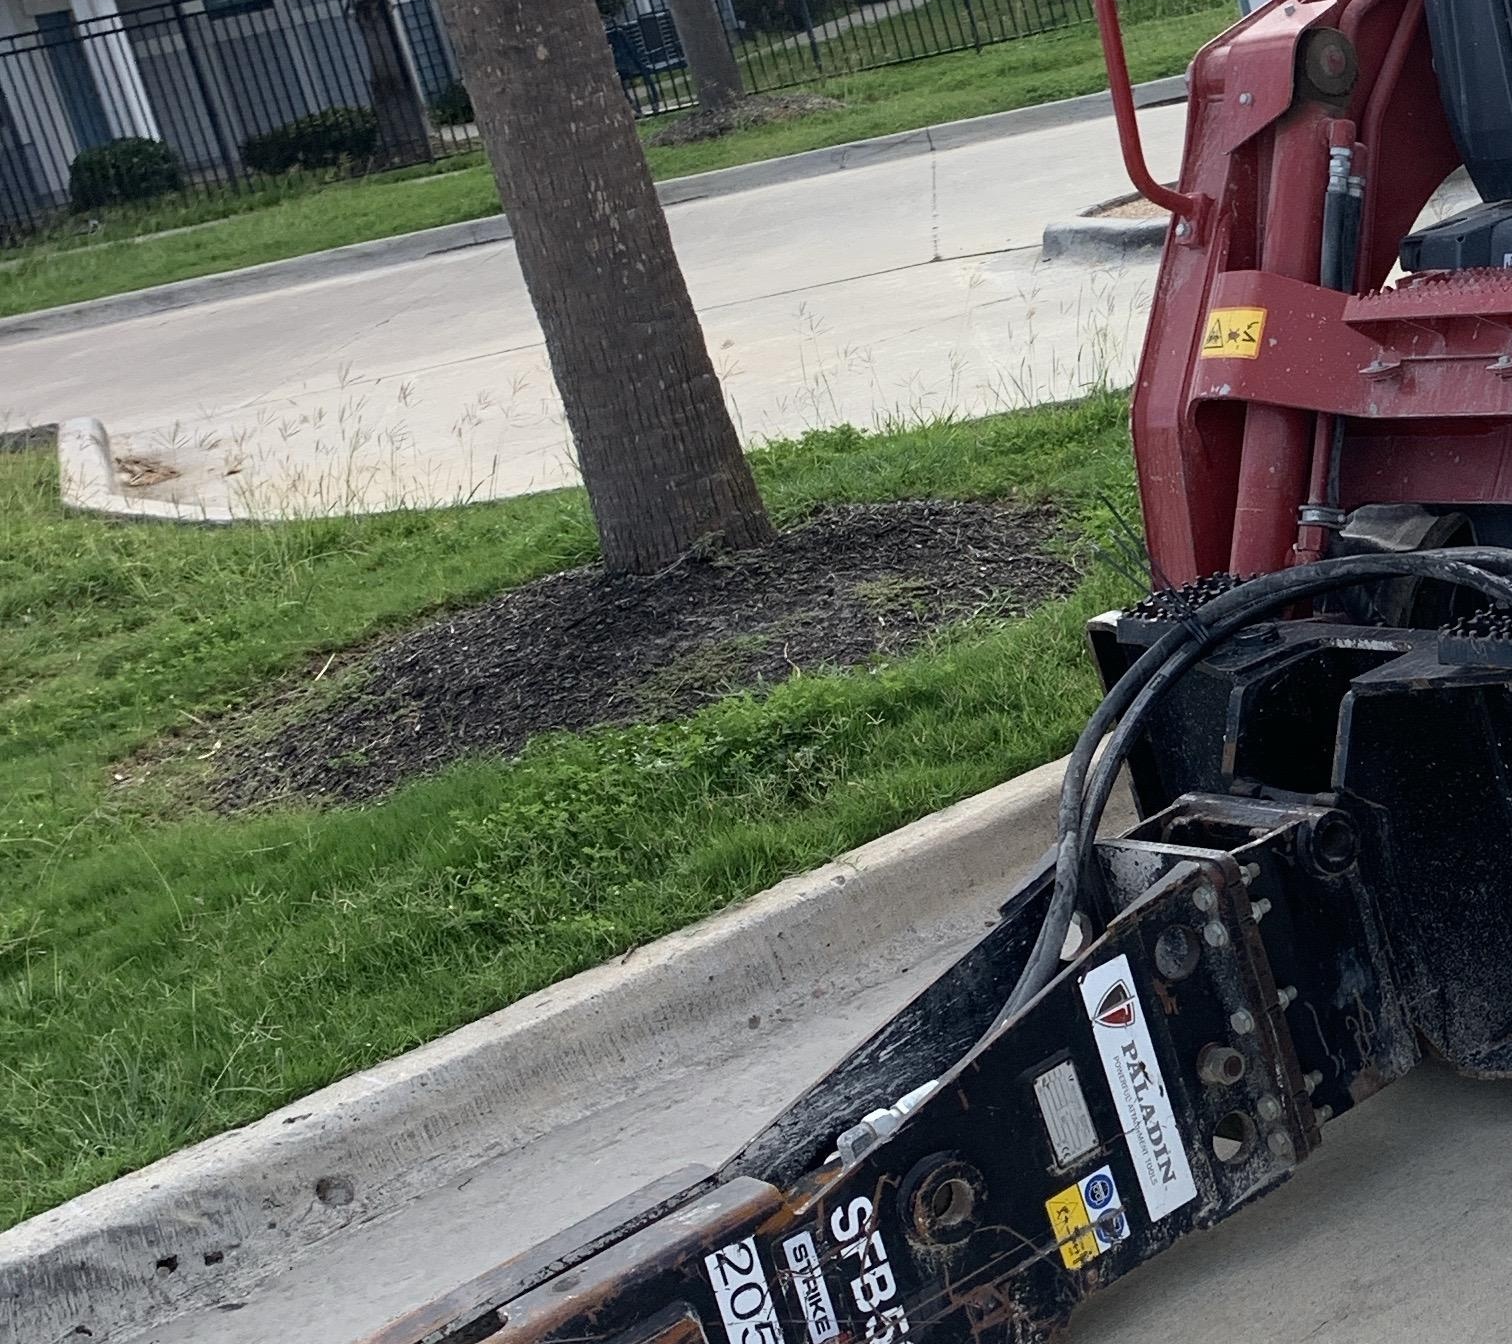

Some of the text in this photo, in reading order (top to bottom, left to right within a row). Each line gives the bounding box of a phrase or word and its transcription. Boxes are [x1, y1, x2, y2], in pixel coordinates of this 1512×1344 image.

[1121, 1040, 1177, 1185] PALADIN
[1144, 1159, 1159, 1187] TOOLS
[793, 1242, 831, 1336] STRIKE
